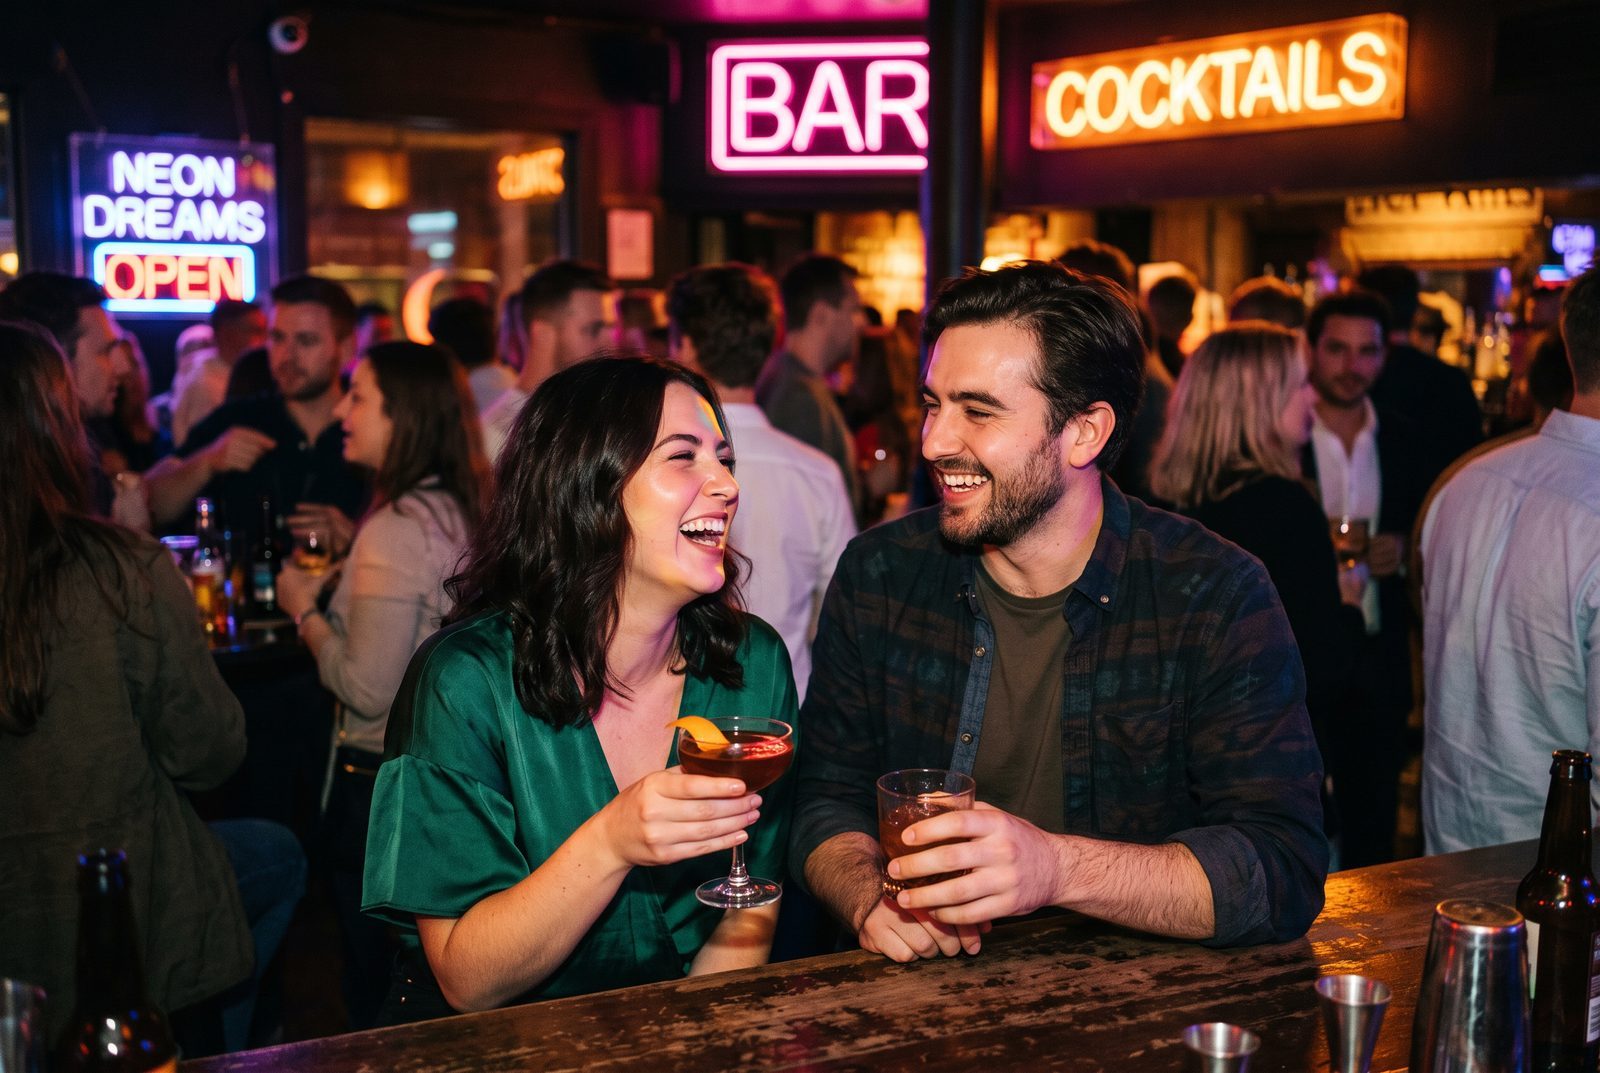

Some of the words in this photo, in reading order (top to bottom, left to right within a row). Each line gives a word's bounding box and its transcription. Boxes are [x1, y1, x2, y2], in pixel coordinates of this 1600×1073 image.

[731, 60, 930, 152] BAR
[1046, 31, 1387, 137] COCKTAILS
[112, 150, 236, 198] NEON
[83, 194, 266, 244] DREAMS
[104, 254, 243, 303] OPEN
